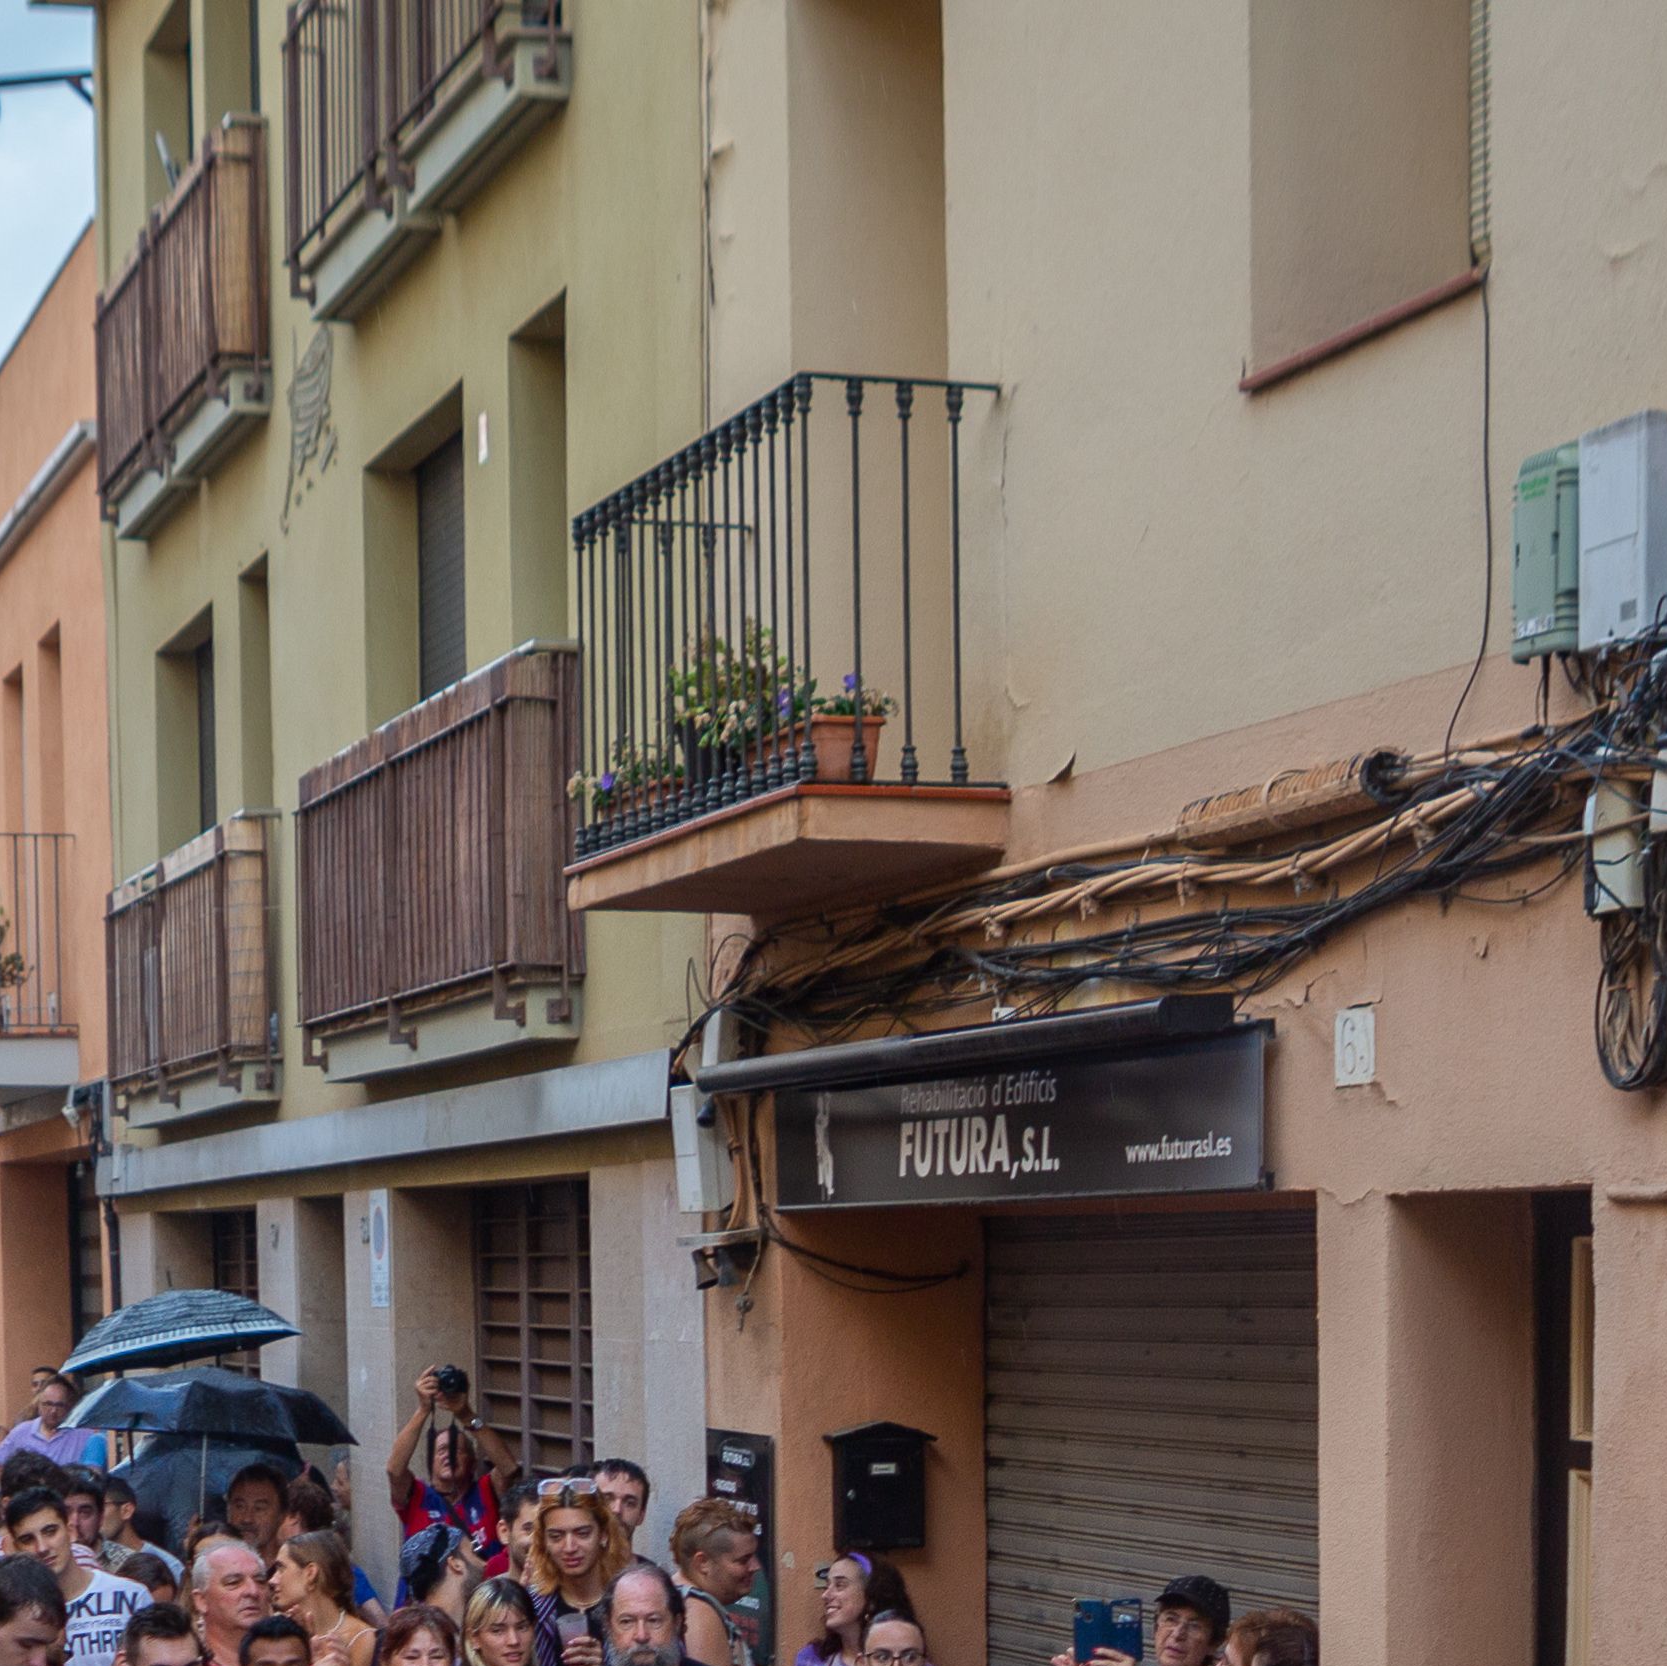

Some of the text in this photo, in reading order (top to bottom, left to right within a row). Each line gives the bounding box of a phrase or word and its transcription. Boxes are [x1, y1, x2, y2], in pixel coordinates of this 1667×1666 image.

[901, 1070, 1057, 1114] Rehabilitació d'Edificis
[1125, 1130, 1232, 1163] www.futurasl.es
